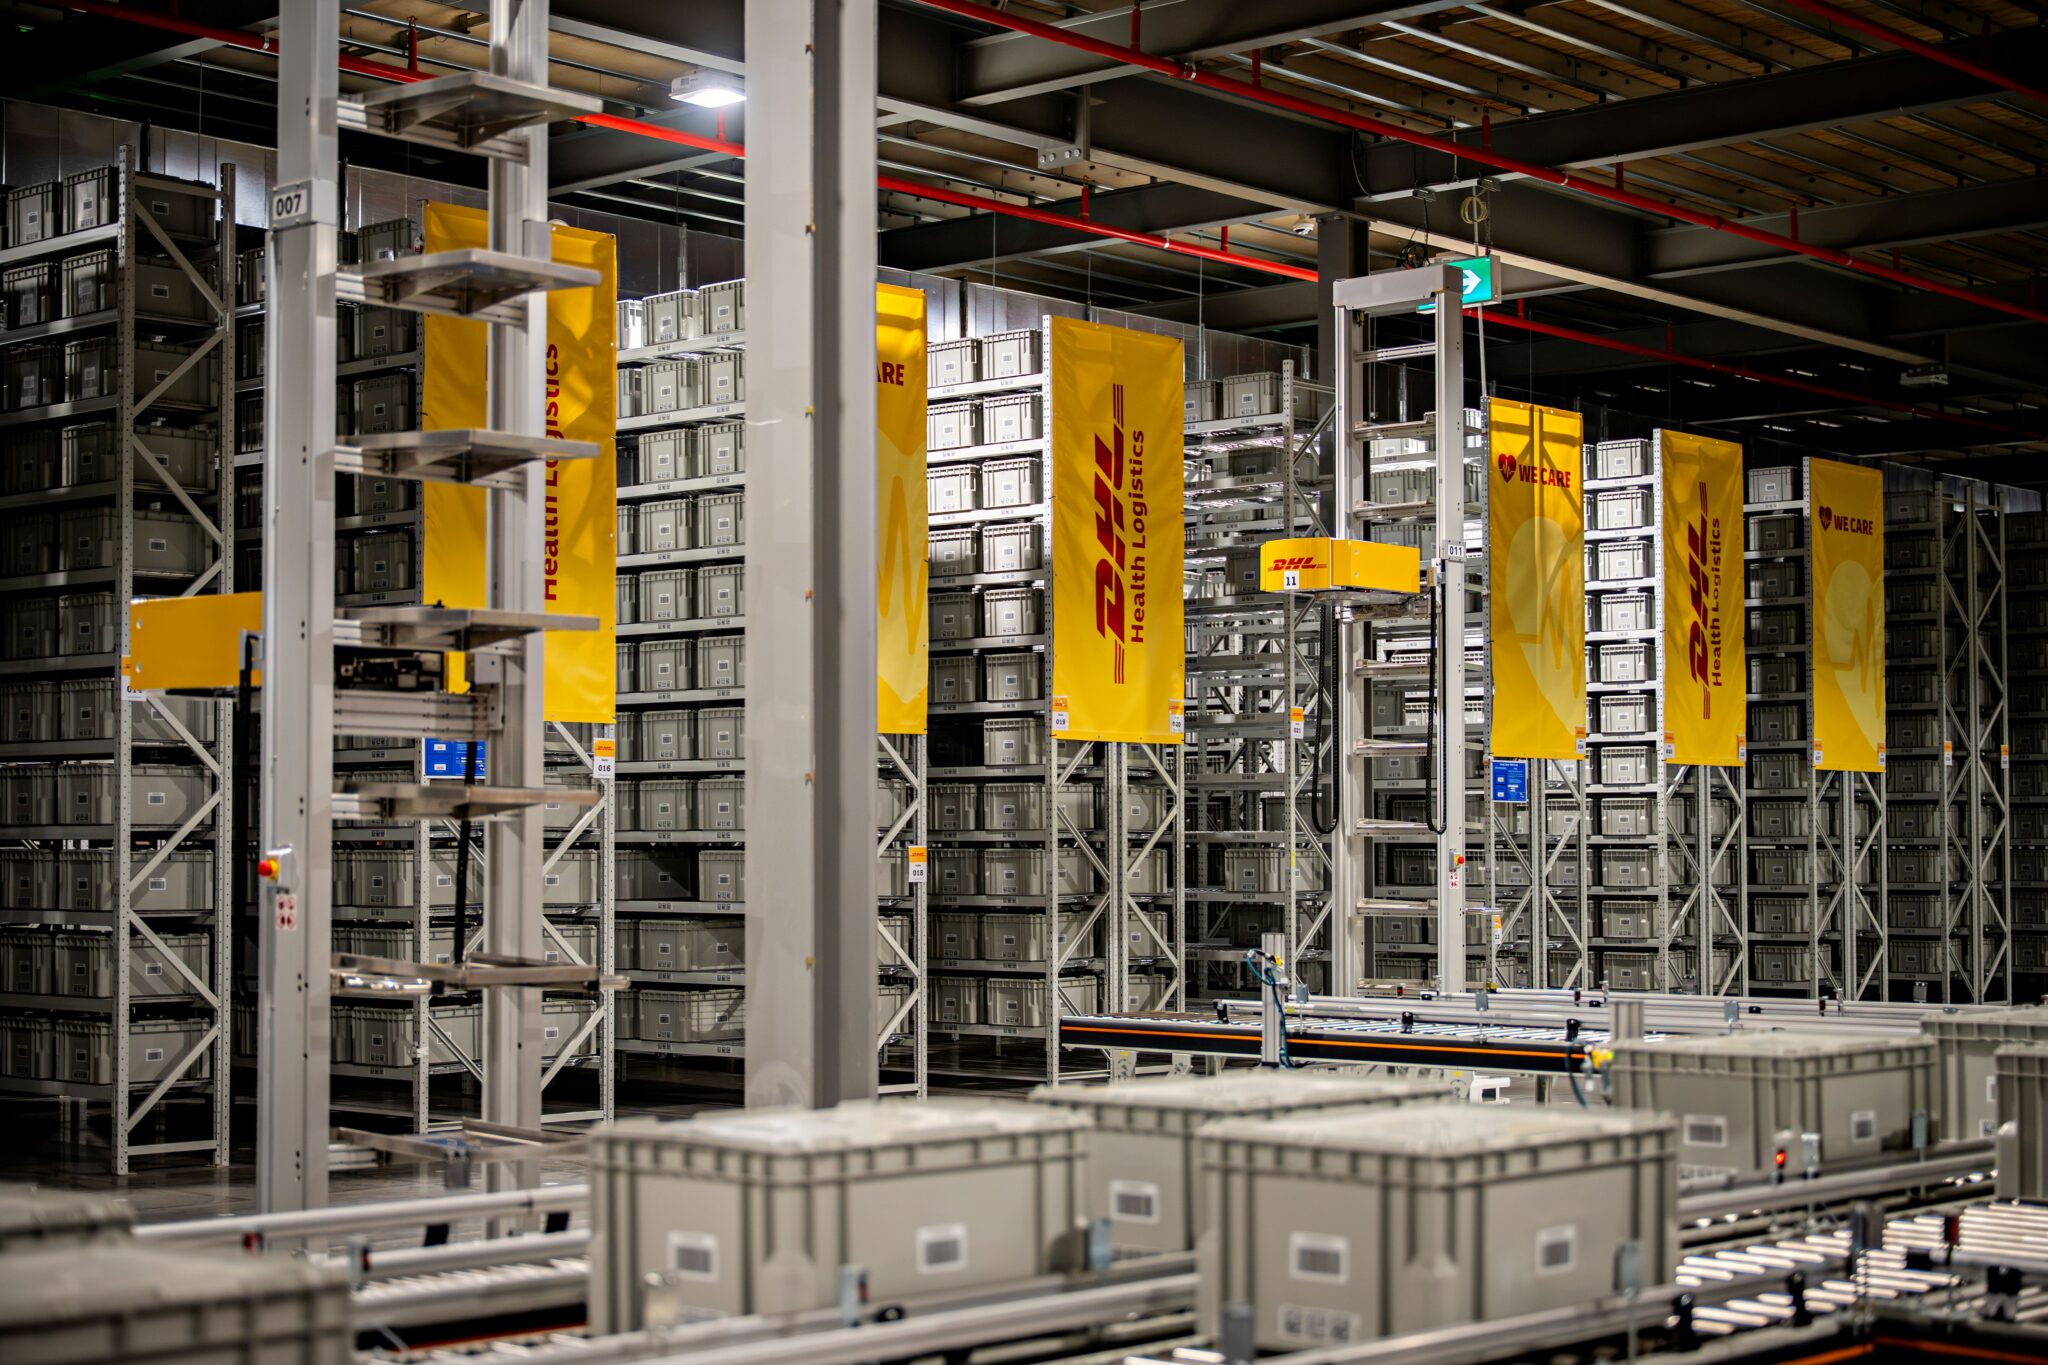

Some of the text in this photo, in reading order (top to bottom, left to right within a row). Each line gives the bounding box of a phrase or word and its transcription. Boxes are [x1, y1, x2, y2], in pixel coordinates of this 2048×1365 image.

[276, 194, 301, 217] 007
[1518, 464, 1571, 488] WE CARE
[1094, 423, 1125, 644] DHL
[1129, 429, 1147, 643] Health Logistics
[1834, 515, 1873, 536] WE CARE
[1449, 545, 1462, 556] 011
[1273, 557, 1316, 571] DHL
[1286, 576, 1297, 586] 11
[1688, 514, 1709, 688] DHL
[1710, 517, 1722, 687] Health Logistics
[597, 764, 612, 772] 016
